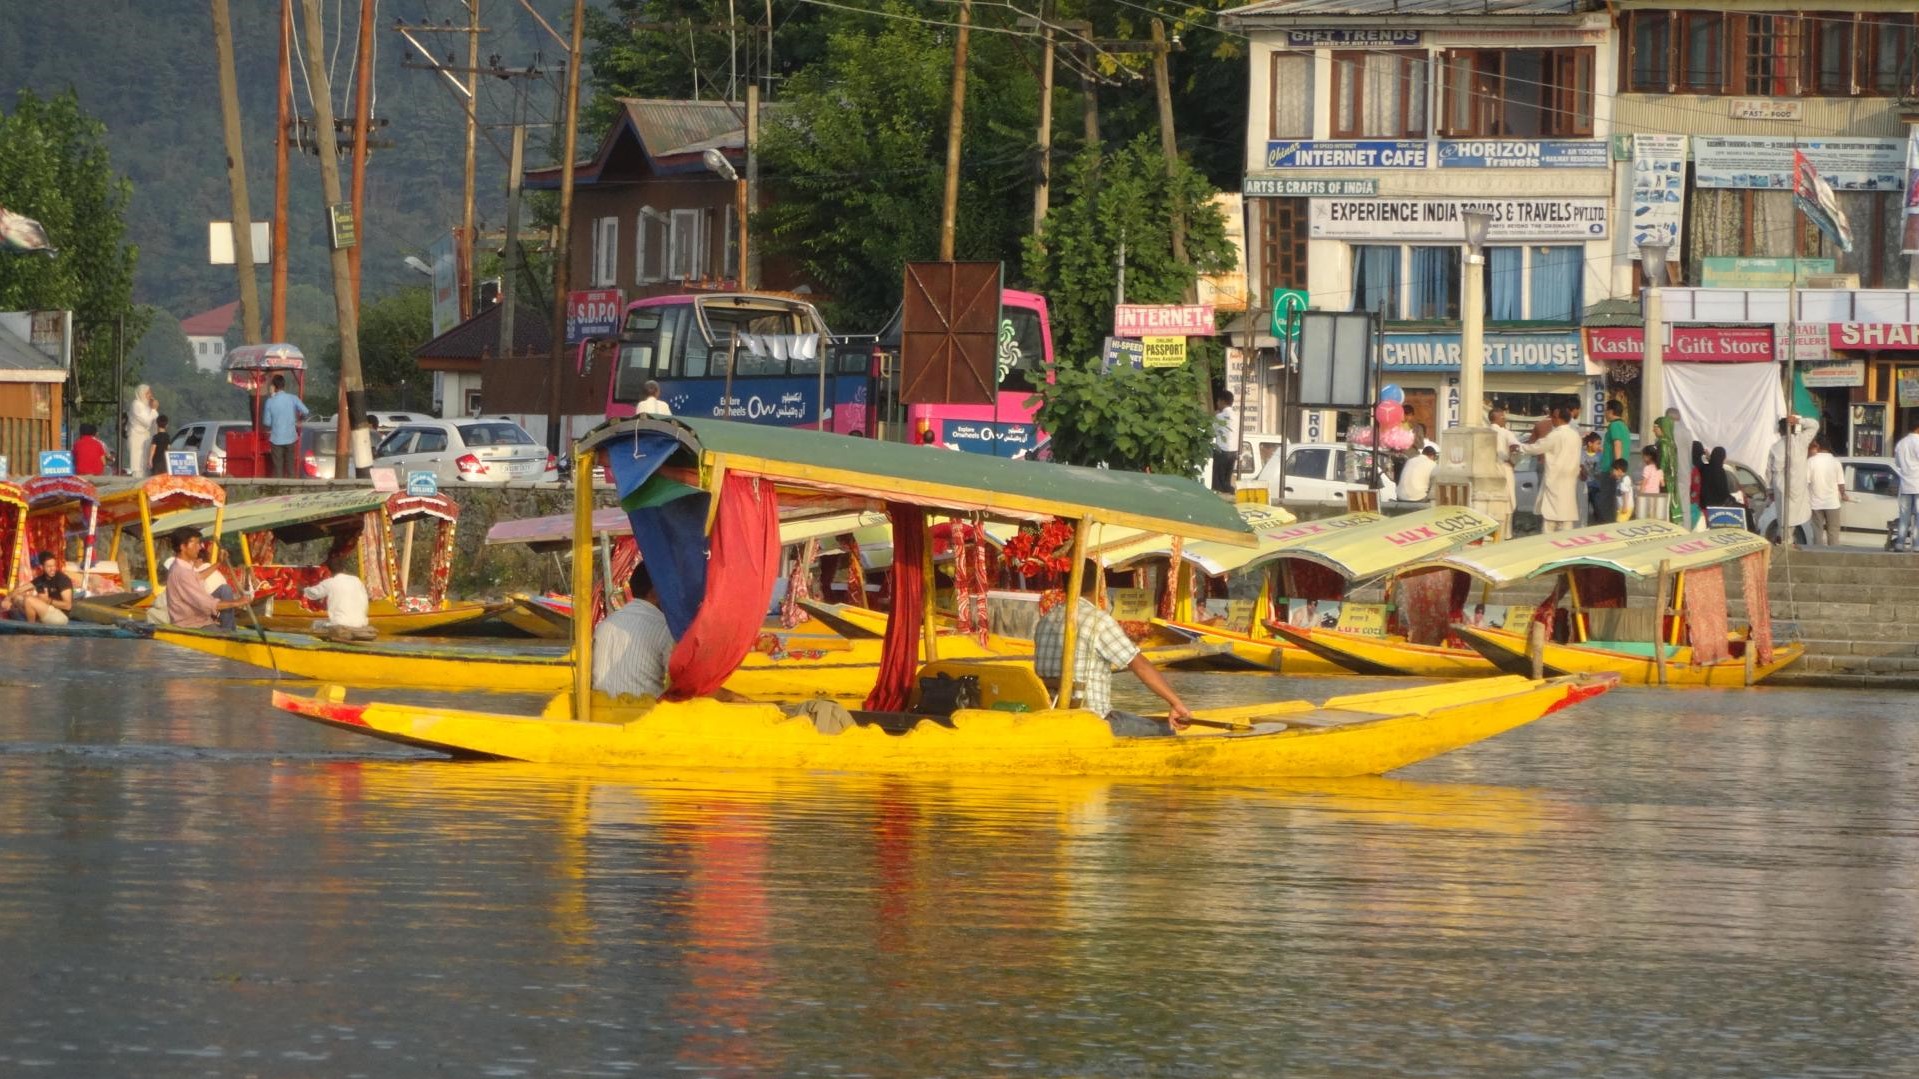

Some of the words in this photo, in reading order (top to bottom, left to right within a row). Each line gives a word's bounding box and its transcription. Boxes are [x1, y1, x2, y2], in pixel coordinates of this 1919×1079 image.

[1291, 30, 1335, 41] GIFT
[1342, 30, 1417, 41] TRENDS
[1268, 142, 1300, 167] Chinar
[1295, 150, 1377, 166] INTERNET
[1381, 150, 1426, 166] CAFE
[1458, 143, 1540, 157] HORIZON
[1484, 157, 1540, 167] Travels
[1246, 181, 1275, 193] ARTS
[1276, 182, 1284, 193] &
[1286, 181, 1326, 193] CRAFTS
[1328, 181, 1341, 193] OF
[1344, 181, 1374, 193] INDIA
[1331, 203, 1418, 221] EXPERIENCE
[1423, 203, 1458, 222] INDIA
[1506, 203, 1514, 221] &
[1517, 203, 1572, 222] TRAVELS
[1119, 308, 1203, 327] INTERNET
[1146, 344, 1183, 355] PASSPORT
[1677, 335, 1715, 354] Gift
[1720, 337, 1770, 354] Store
[1383, 343, 1461, 365] CHINAR
[1510, 343, 1579, 366] HOUSE
[1265, 525, 1327, 541] LUX
[1384, 526, 1438, 545] LUX
[1551, 532, 1617, 548] LUX
[1665, 540, 1715, 554] LUX
